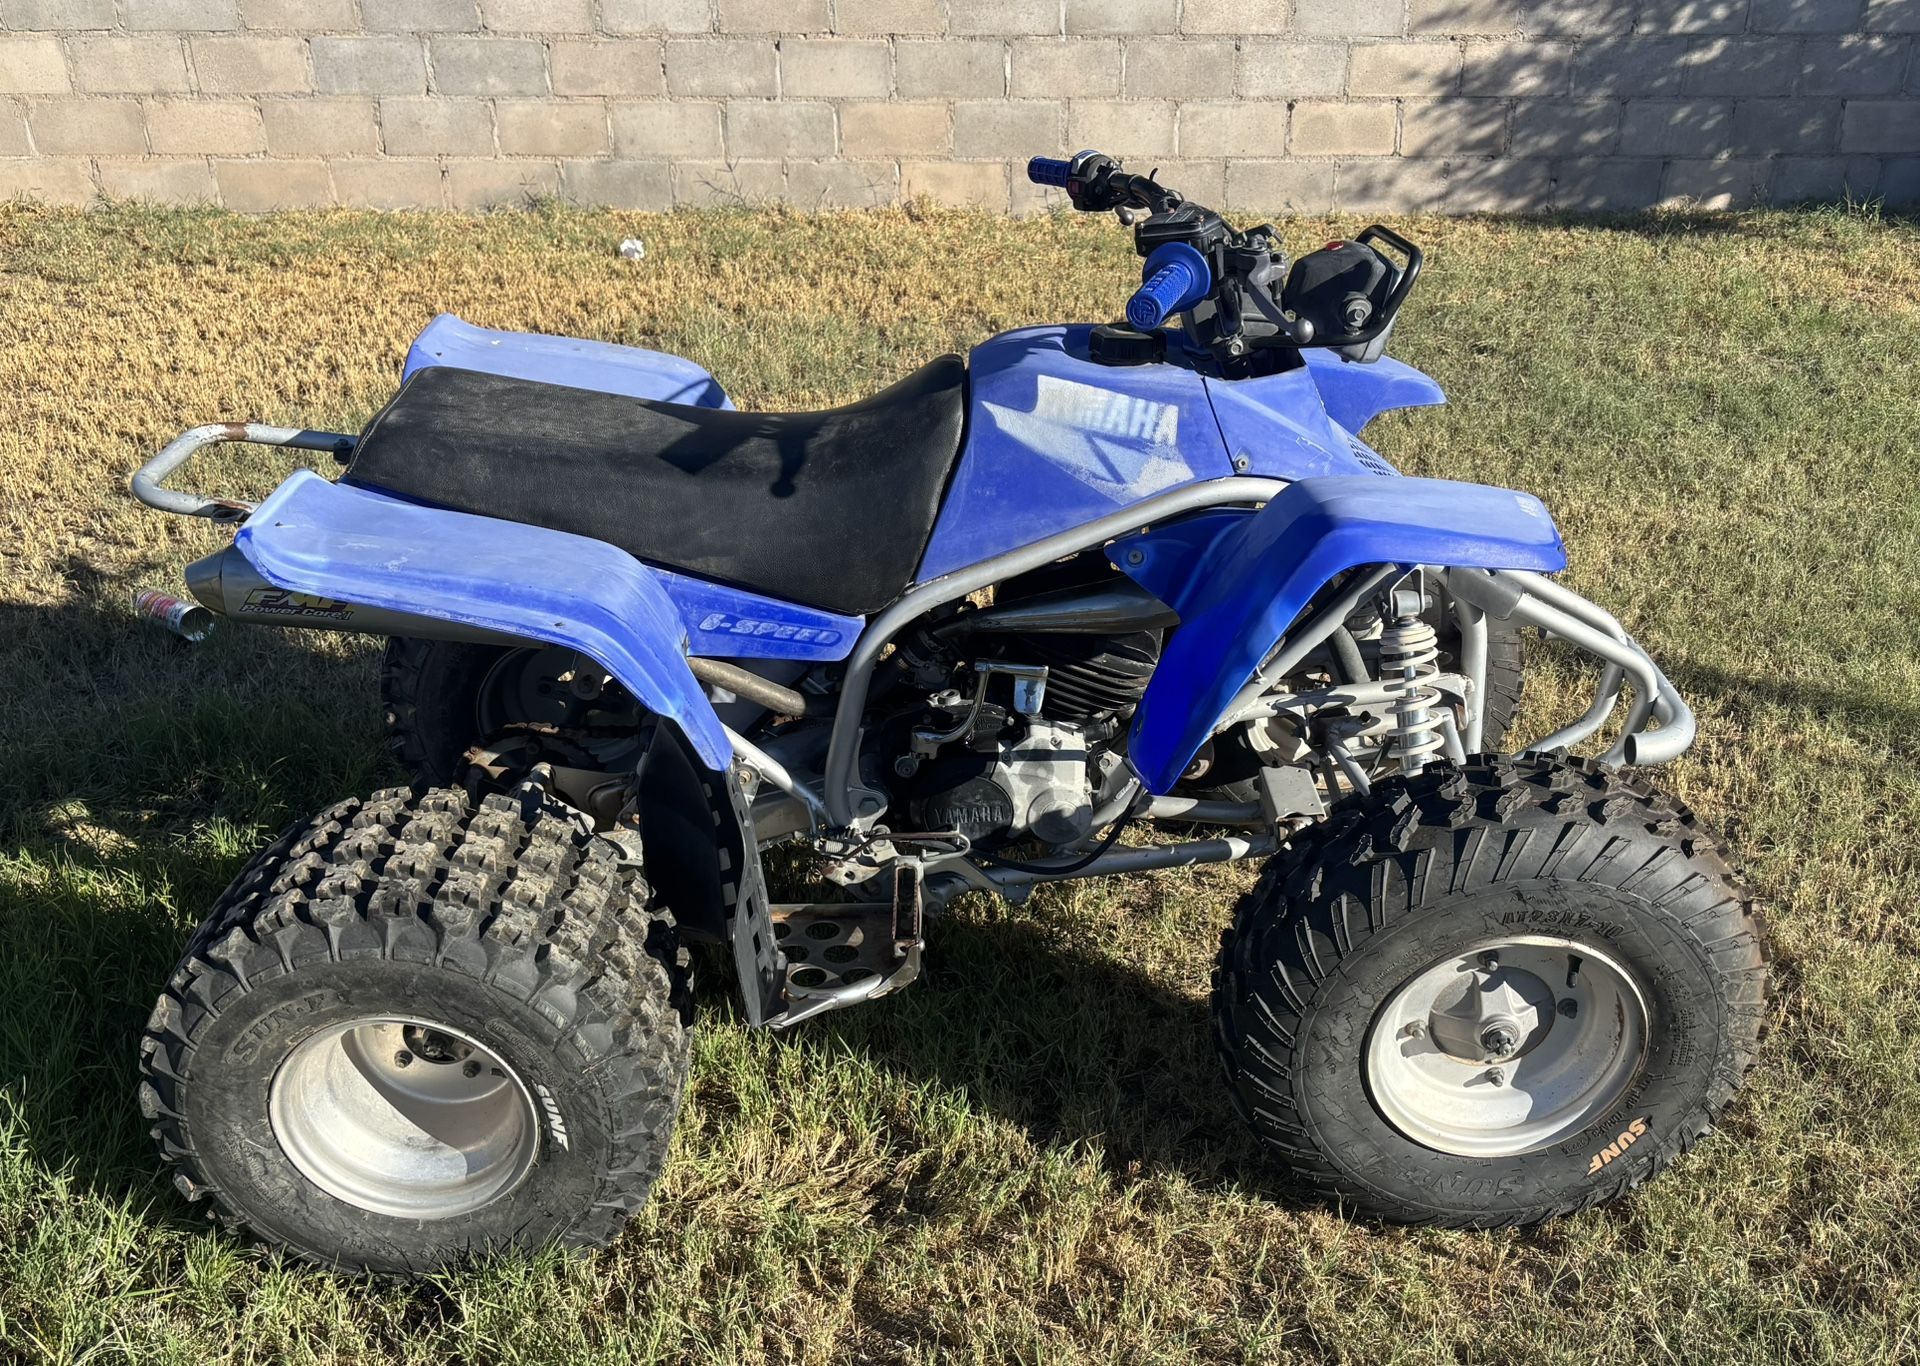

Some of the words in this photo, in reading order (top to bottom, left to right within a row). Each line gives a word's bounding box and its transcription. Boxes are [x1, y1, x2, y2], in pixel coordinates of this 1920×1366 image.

[241, 604, 299, 615] Power
[935, 805, 1006, 823] YAMAHA
[532, 1081, 569, 1152] SUNF
[1587, 1116, 1648, 1176] SUNF
